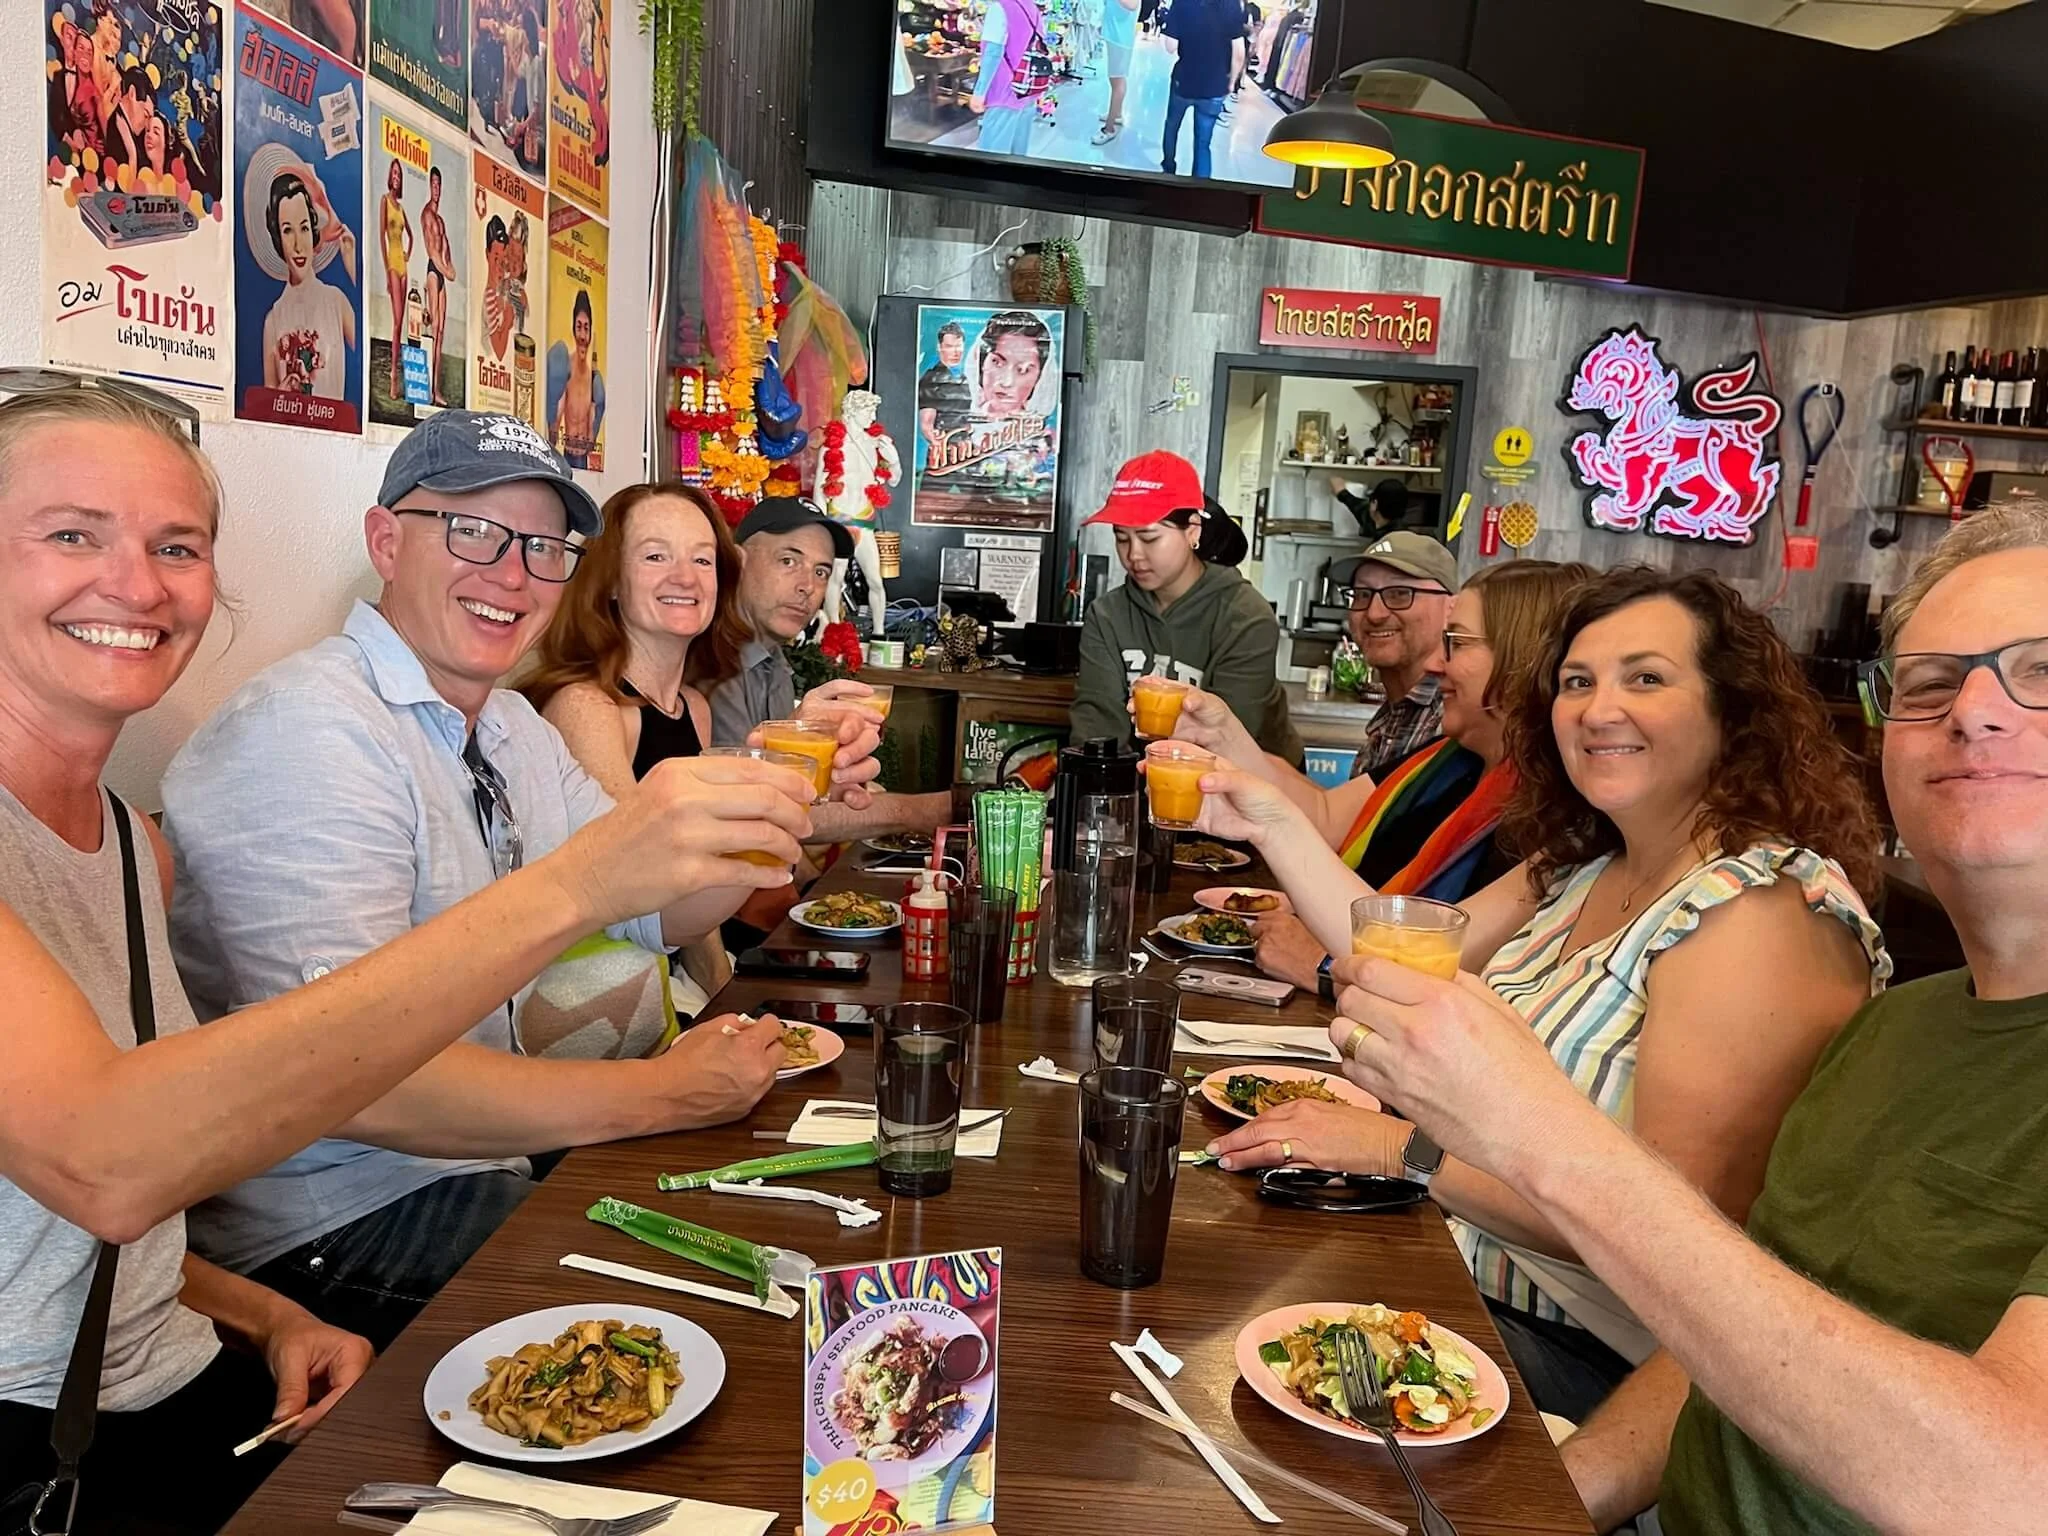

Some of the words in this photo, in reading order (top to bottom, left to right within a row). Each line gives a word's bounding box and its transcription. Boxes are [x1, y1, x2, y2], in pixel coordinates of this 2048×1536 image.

[105, 264, 215, 337] โบตัน
[1267, 292, 1433, 350] ไทยสตรีทฟู้ด
[117, 325, 216, 362] เด่นในทุกวงสังคม
[986, 553, 1033, 565] WARNING
[970, 720, 997, 739] live
[973, 736, 997, 751] life
[965, 744, 1004, 764] large
[889, 1302, 960, 1321] PANCAKE
[827, 1308, 886, 1361] SEAFOOD
[814, 1361, 832, 1417] CRISPY
[818, 1417, 845, 1450] THAI
[816, 1477, 868, 1510] $40
